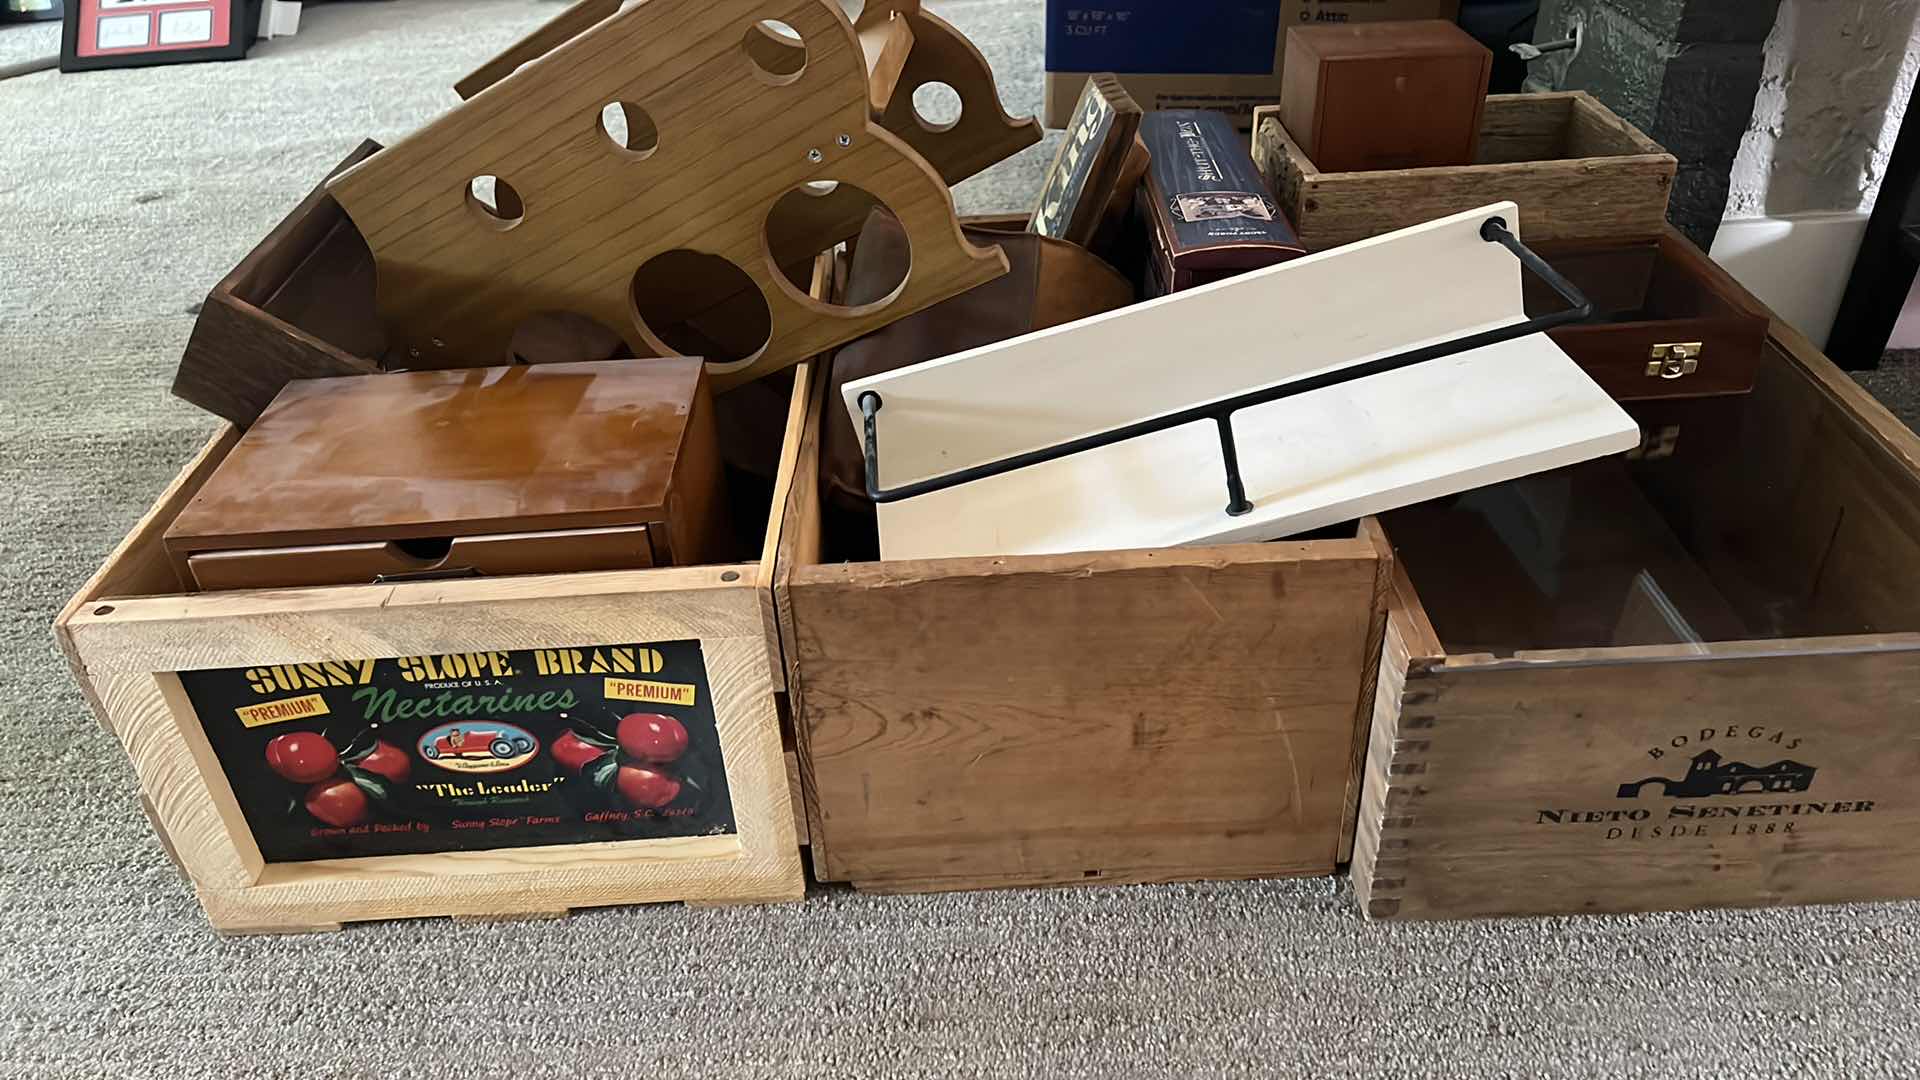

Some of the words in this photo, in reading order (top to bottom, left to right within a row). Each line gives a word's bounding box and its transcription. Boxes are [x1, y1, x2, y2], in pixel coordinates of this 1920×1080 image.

[246, 658, 376, 694] SUNNY
[398, 650, 514, 683] SLOPE
[534, 648, 664, 676] BRAND
[352, 686, 580, 723] Nectarines
[610, 682, 689, 701] "PREMIUM"
[242, 696, 318, 723] "PREMIUM"
[1648, 724, 1803, 760] BODEGAS
[1606, 823, 1709, 840] DESDE
[1729, 821, 1796, 836] 1888
